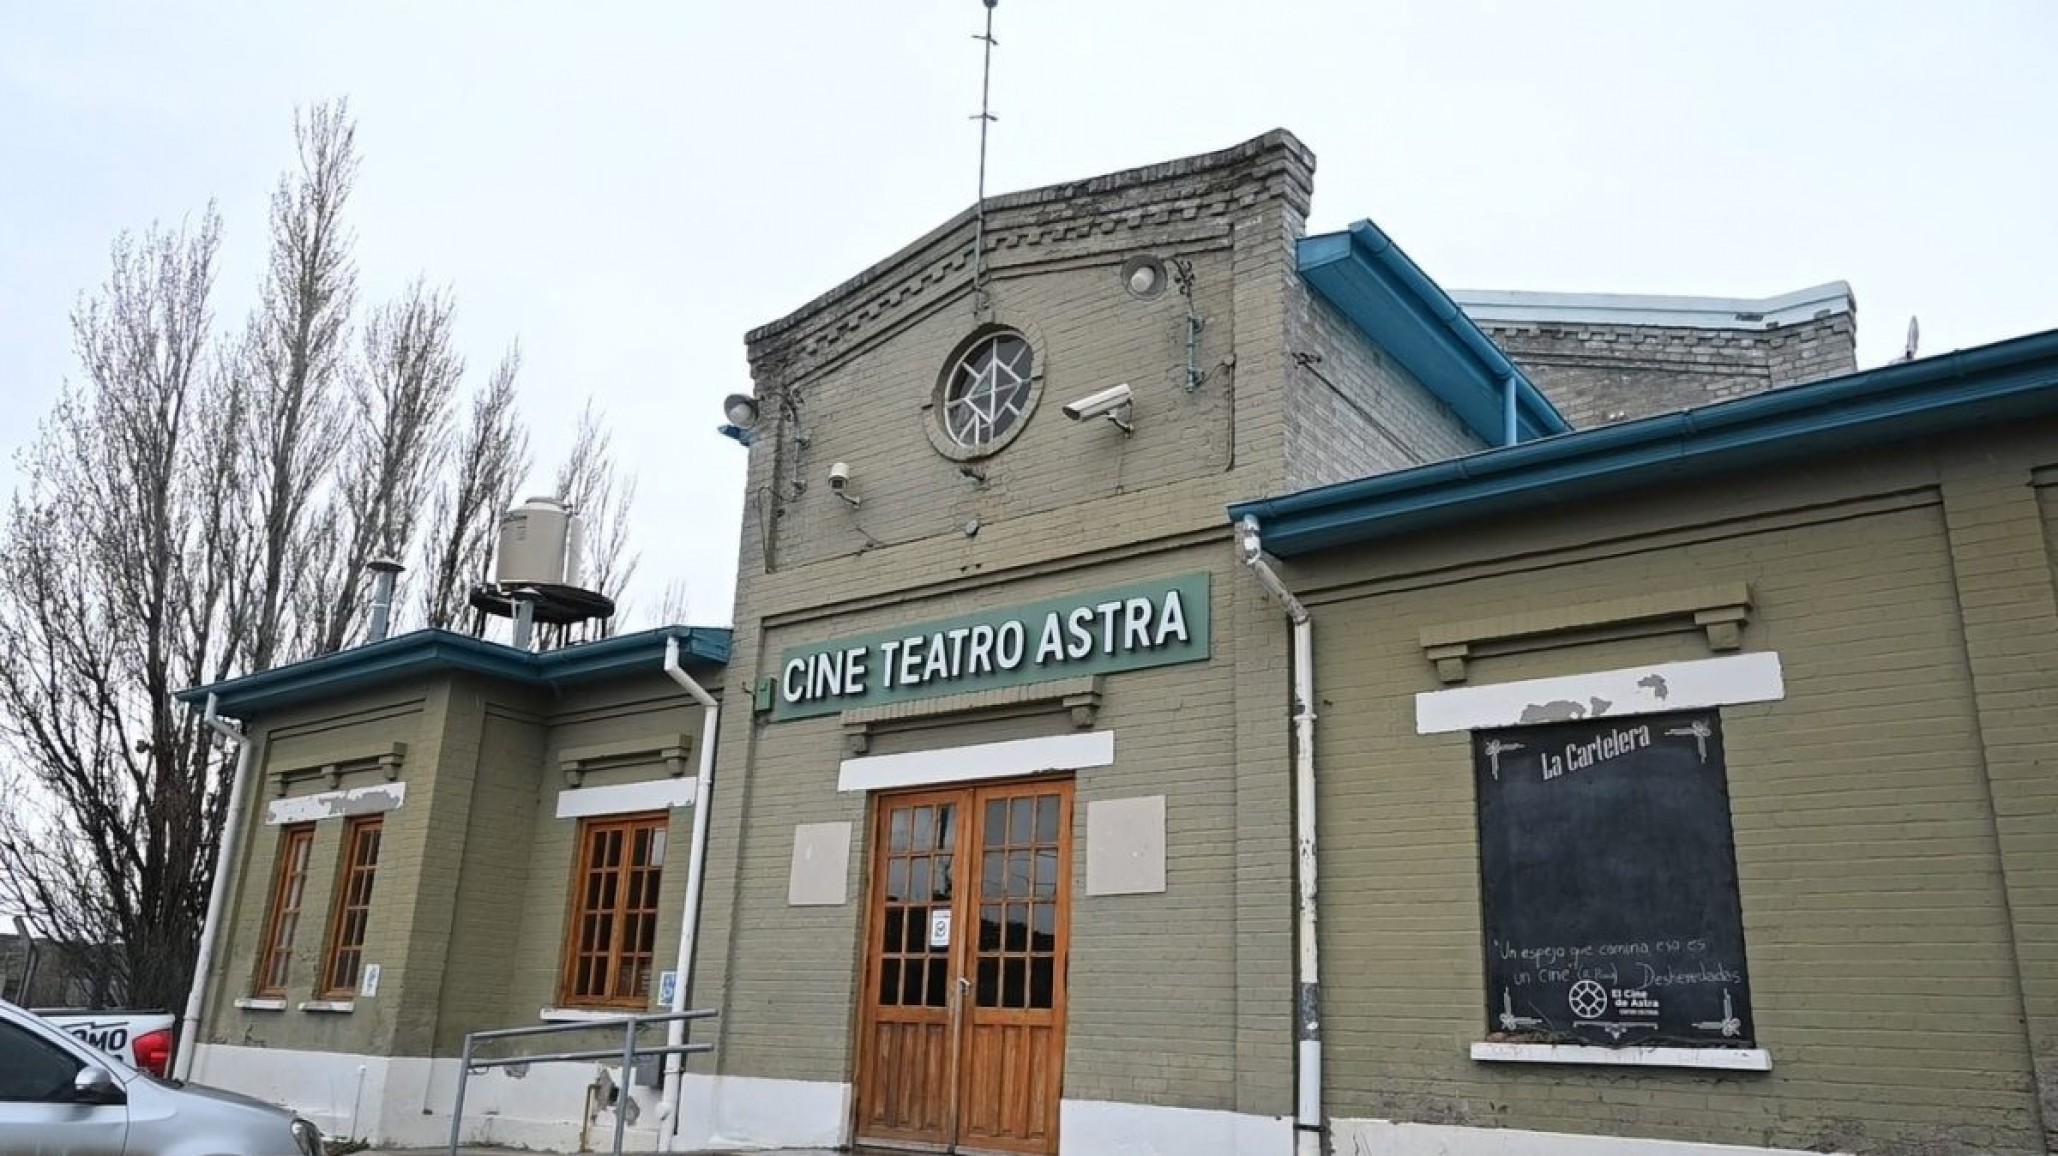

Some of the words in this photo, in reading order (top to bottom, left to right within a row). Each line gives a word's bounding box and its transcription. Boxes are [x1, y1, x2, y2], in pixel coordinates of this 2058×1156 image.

[782, 646, 867, 703] CINE
[880, 620, 1024, 688] TEATRO
[1036, 590, 1188, 664] ASTRA
[1541, 752, 1562, 780] La
[1565, 725, 1651, 771] Cartelera
[1520, 946, 1565, 969] espejo
[1612, 989, 1621, 998] El
[1624, 989, 1647, 998] Cine
[1615, 1000, 1628, 1008] de
[1630, 1000, 1659, 1008] Astra
